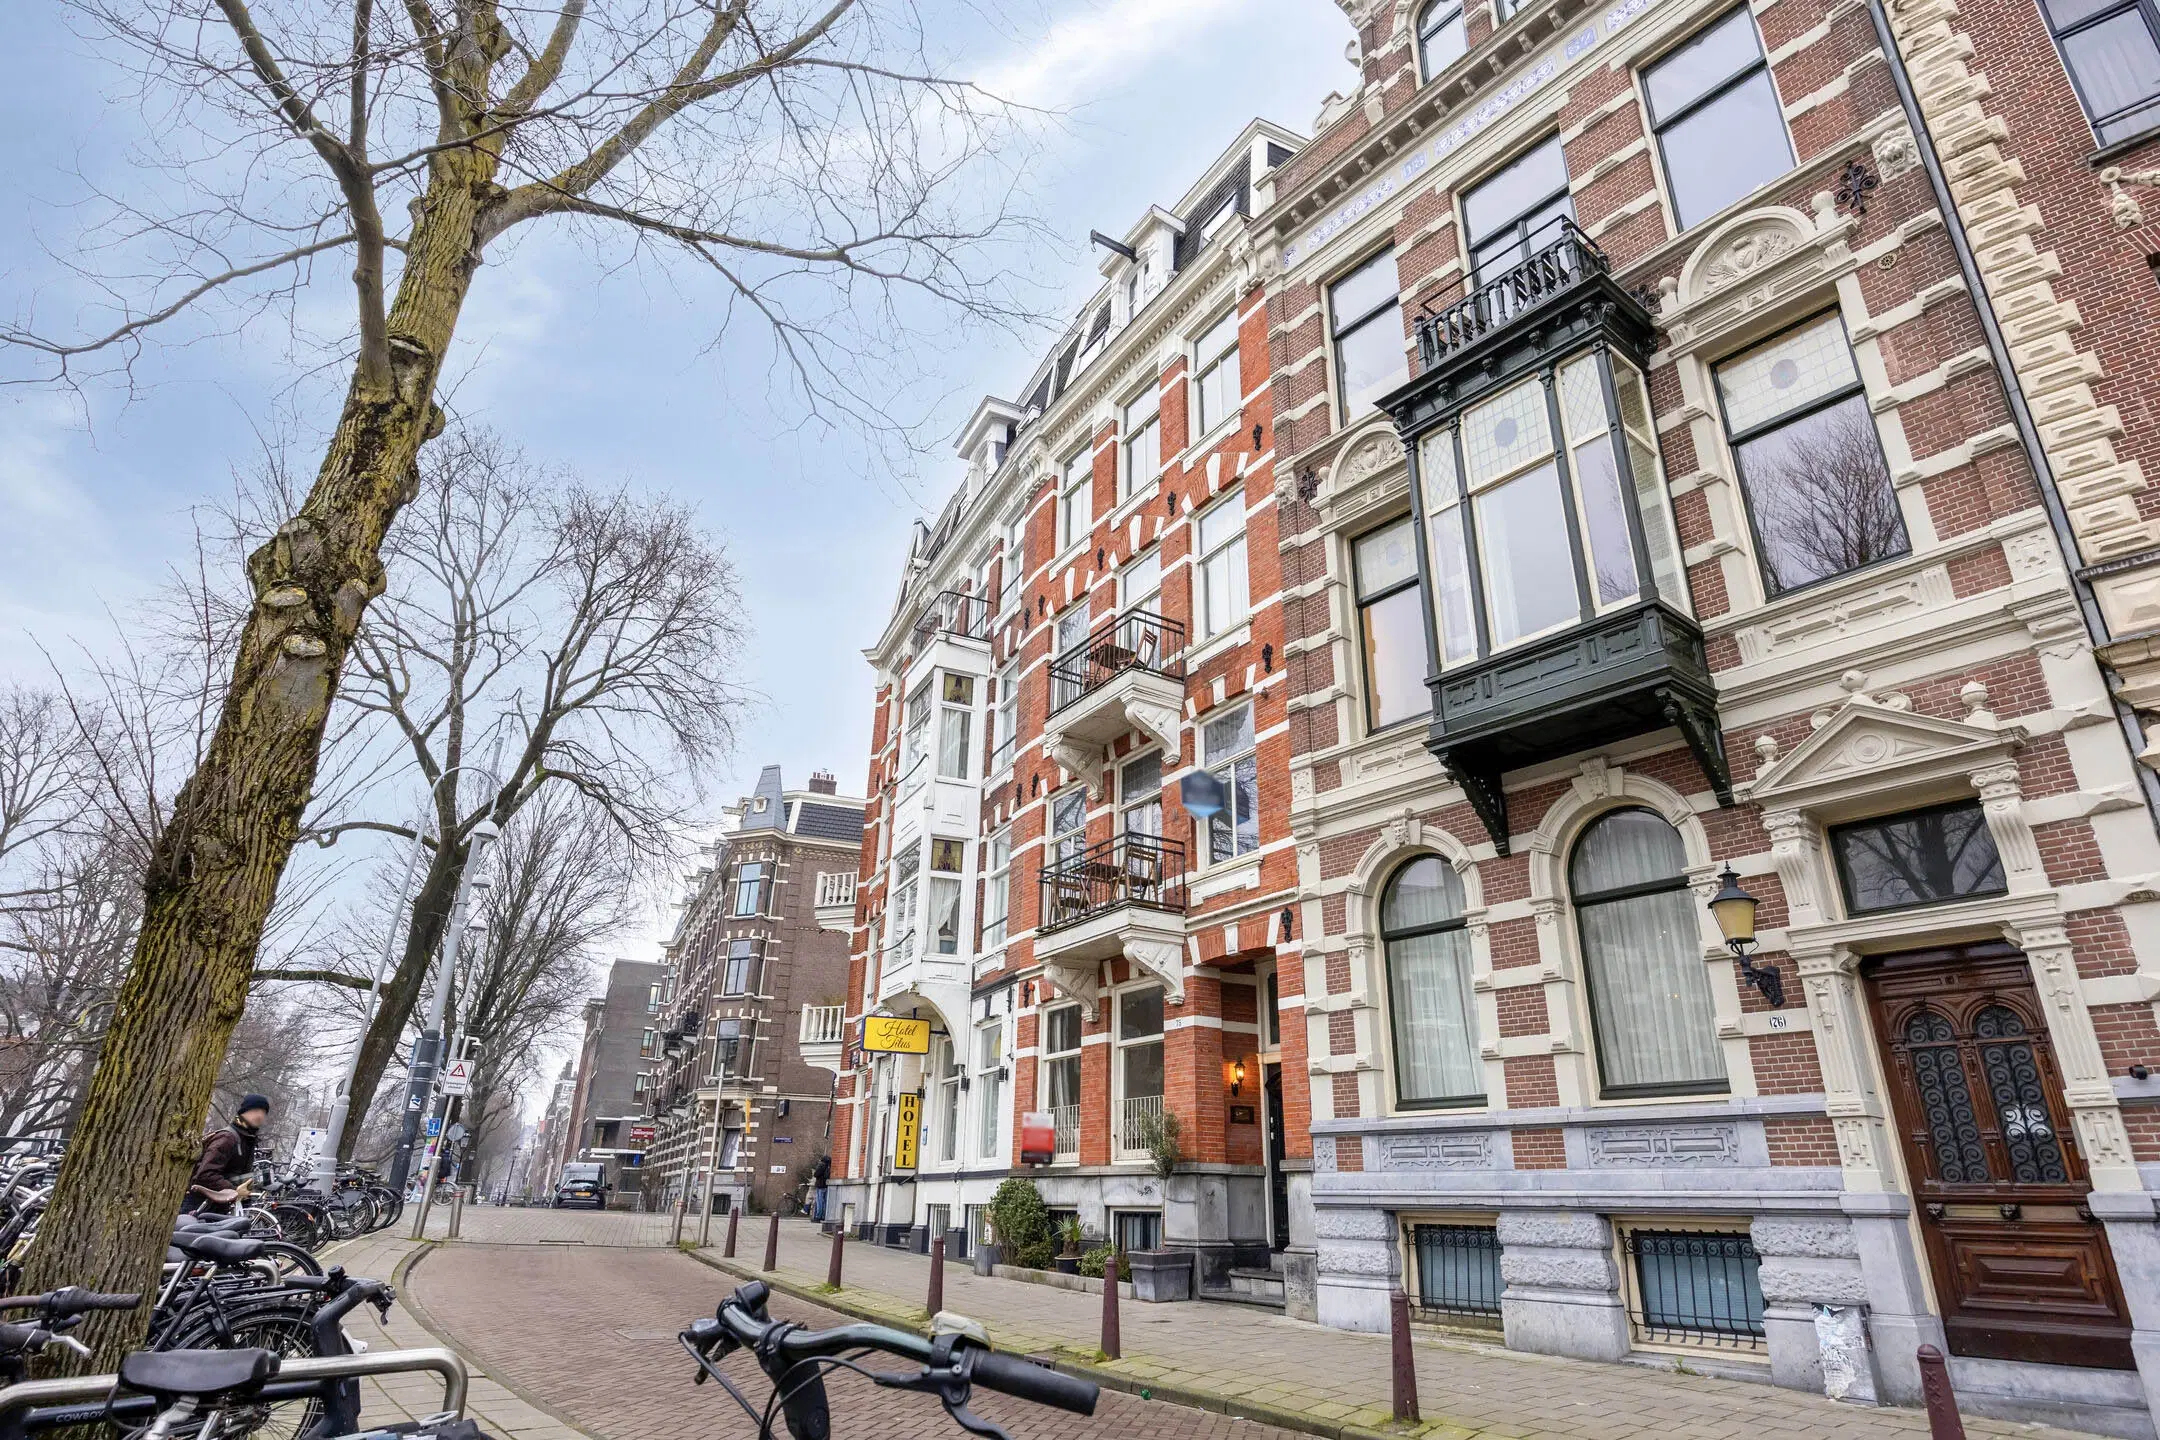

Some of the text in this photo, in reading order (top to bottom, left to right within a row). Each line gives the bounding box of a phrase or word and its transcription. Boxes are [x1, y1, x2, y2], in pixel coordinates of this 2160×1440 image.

[877, 1020, 917, 1036] Hotel
[880, 1034, 911, 1049] Titus
[902, 1096, 915, 1166] HOTEL
[56, 1409, 106, 1423] COWBOY
